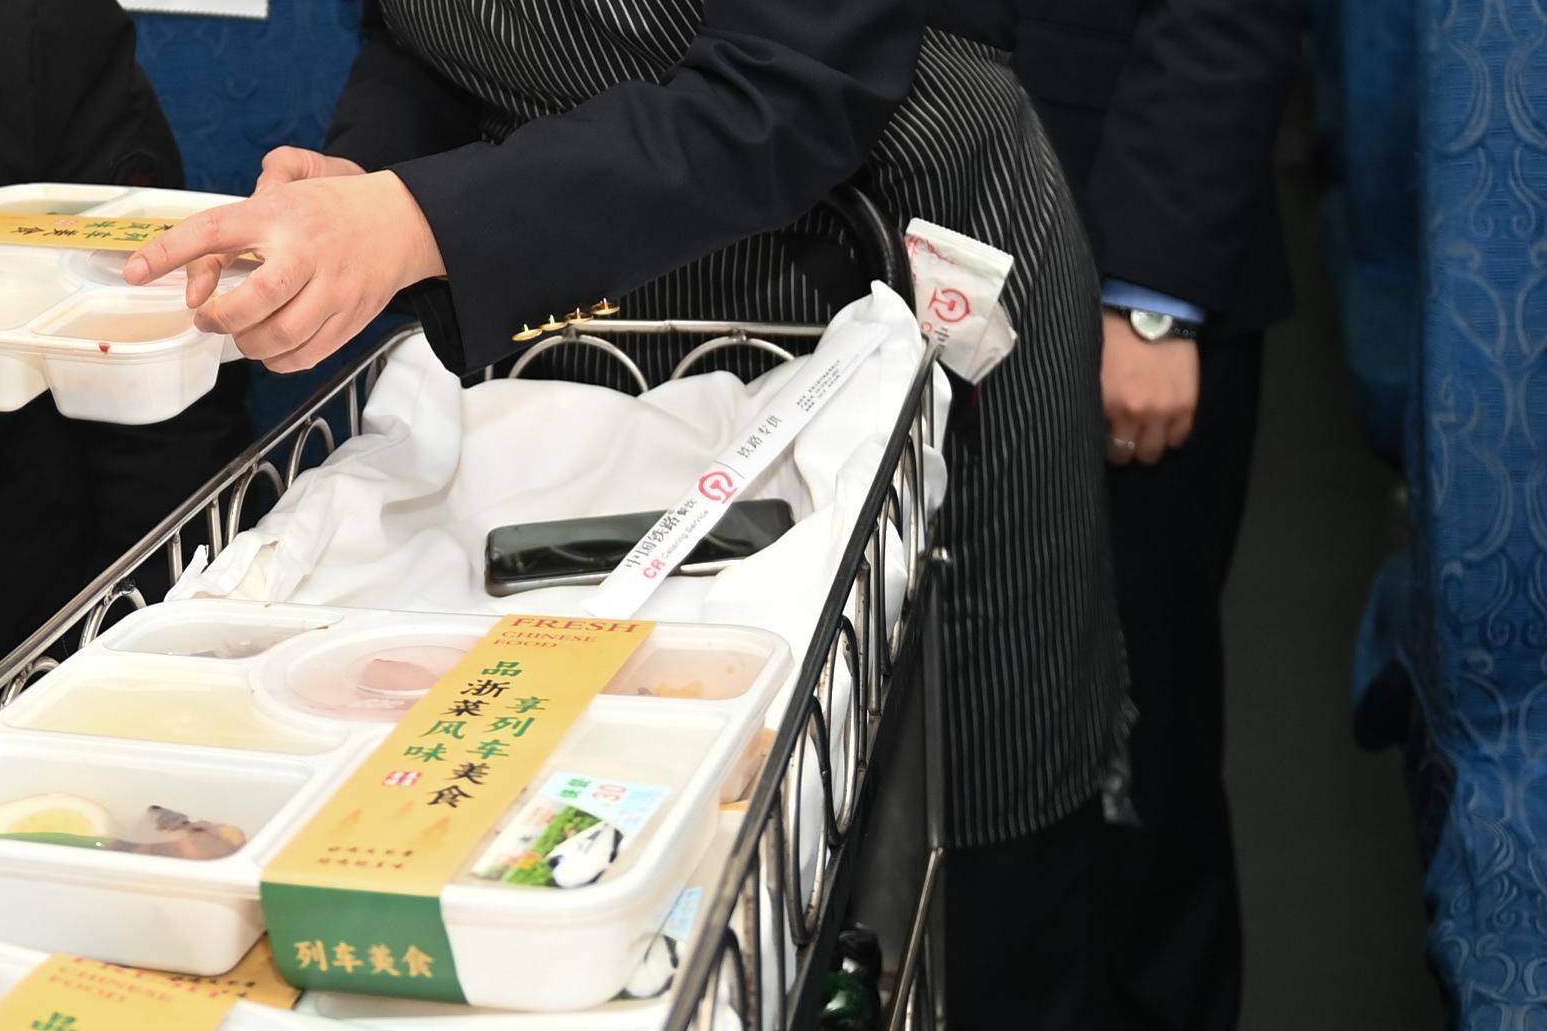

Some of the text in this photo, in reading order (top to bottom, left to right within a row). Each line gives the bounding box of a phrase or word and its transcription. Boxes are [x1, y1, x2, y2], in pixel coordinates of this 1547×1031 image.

[643, 558, 666, 579] CR
[512, 617, 640, 634] FRESH
[493, 639, 558, 648] FOOD
[501, 630, 597, 644] CHINESE
[404, 660, 523, 763] 品浙菜风味
[427, 696, 550, 808] 享列车美食
[293, 939, 435, 979] 列车美食
